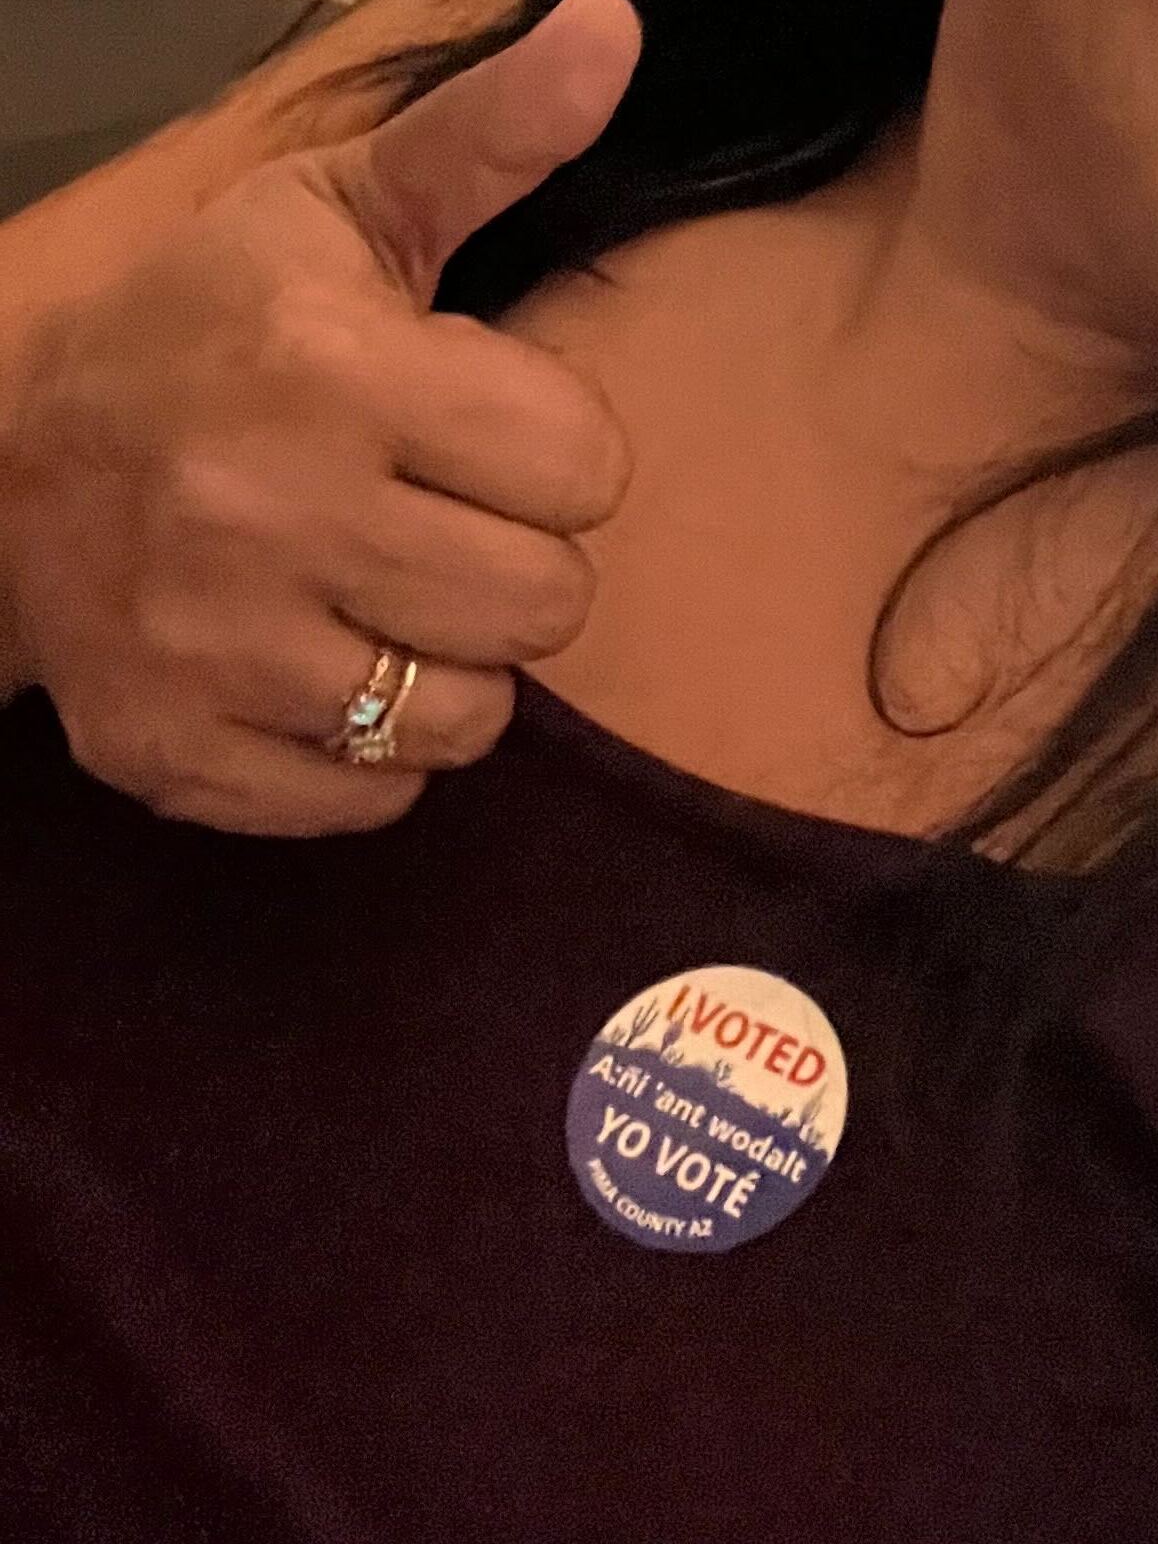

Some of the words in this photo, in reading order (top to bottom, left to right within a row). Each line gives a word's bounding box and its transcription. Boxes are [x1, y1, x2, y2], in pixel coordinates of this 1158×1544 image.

[666, 984, 690, 1020] I
[689, 993, 827, 1088] VOTED
[595, 1105, 650, 1159] YO
[655, 1135, 761, 1219] VOTÉ
[708, 1114, 807, 1183] wodalt
[616, 1195, 685, 1237] COUNTY
